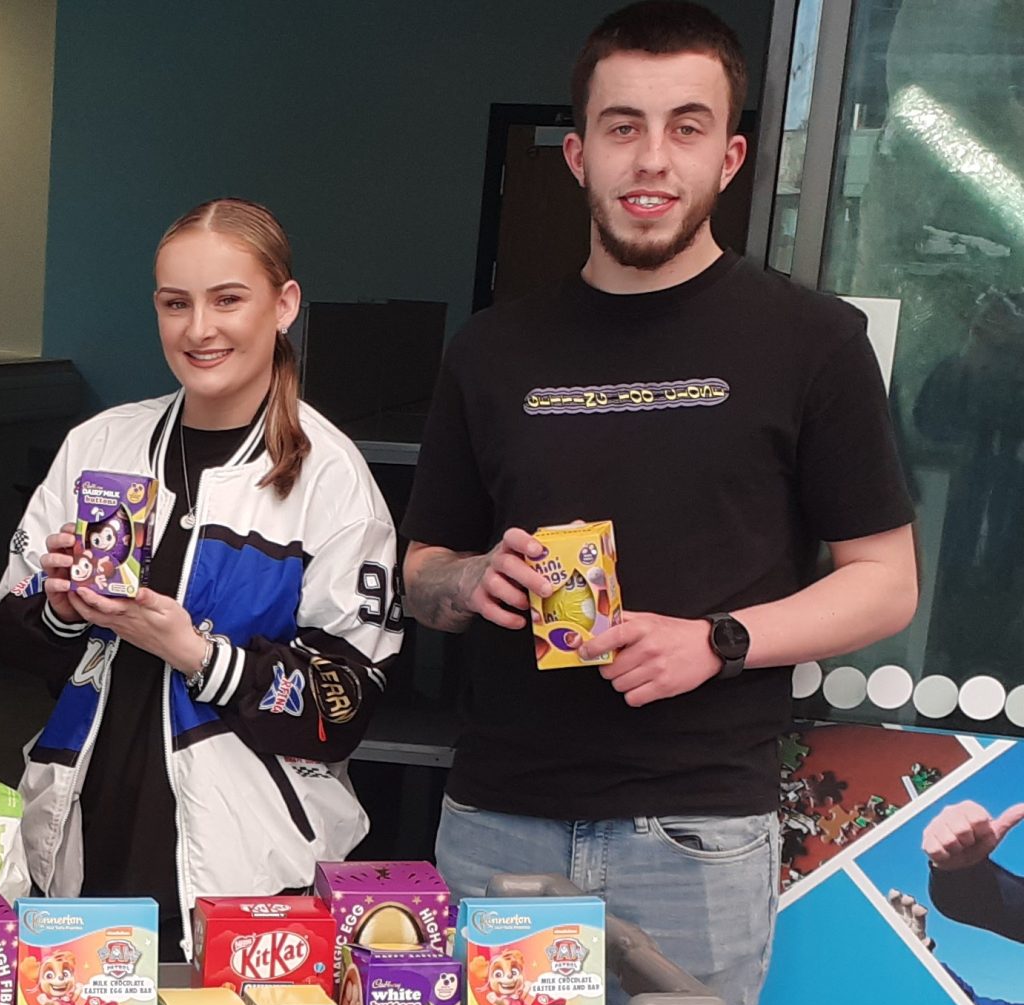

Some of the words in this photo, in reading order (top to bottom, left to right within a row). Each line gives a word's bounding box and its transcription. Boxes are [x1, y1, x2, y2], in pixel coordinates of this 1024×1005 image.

[82, 488, 103, 497] DAIRY
[103, 490, 121, 499] MILK
[85, 496, 117, 505] buttons
[341, 904, 364, 934] EGG
[240, 931, 306, 979] KitKat
[558, 976, 593, 984] CHOCOLATE
[371, 987, 422, 1001] white
